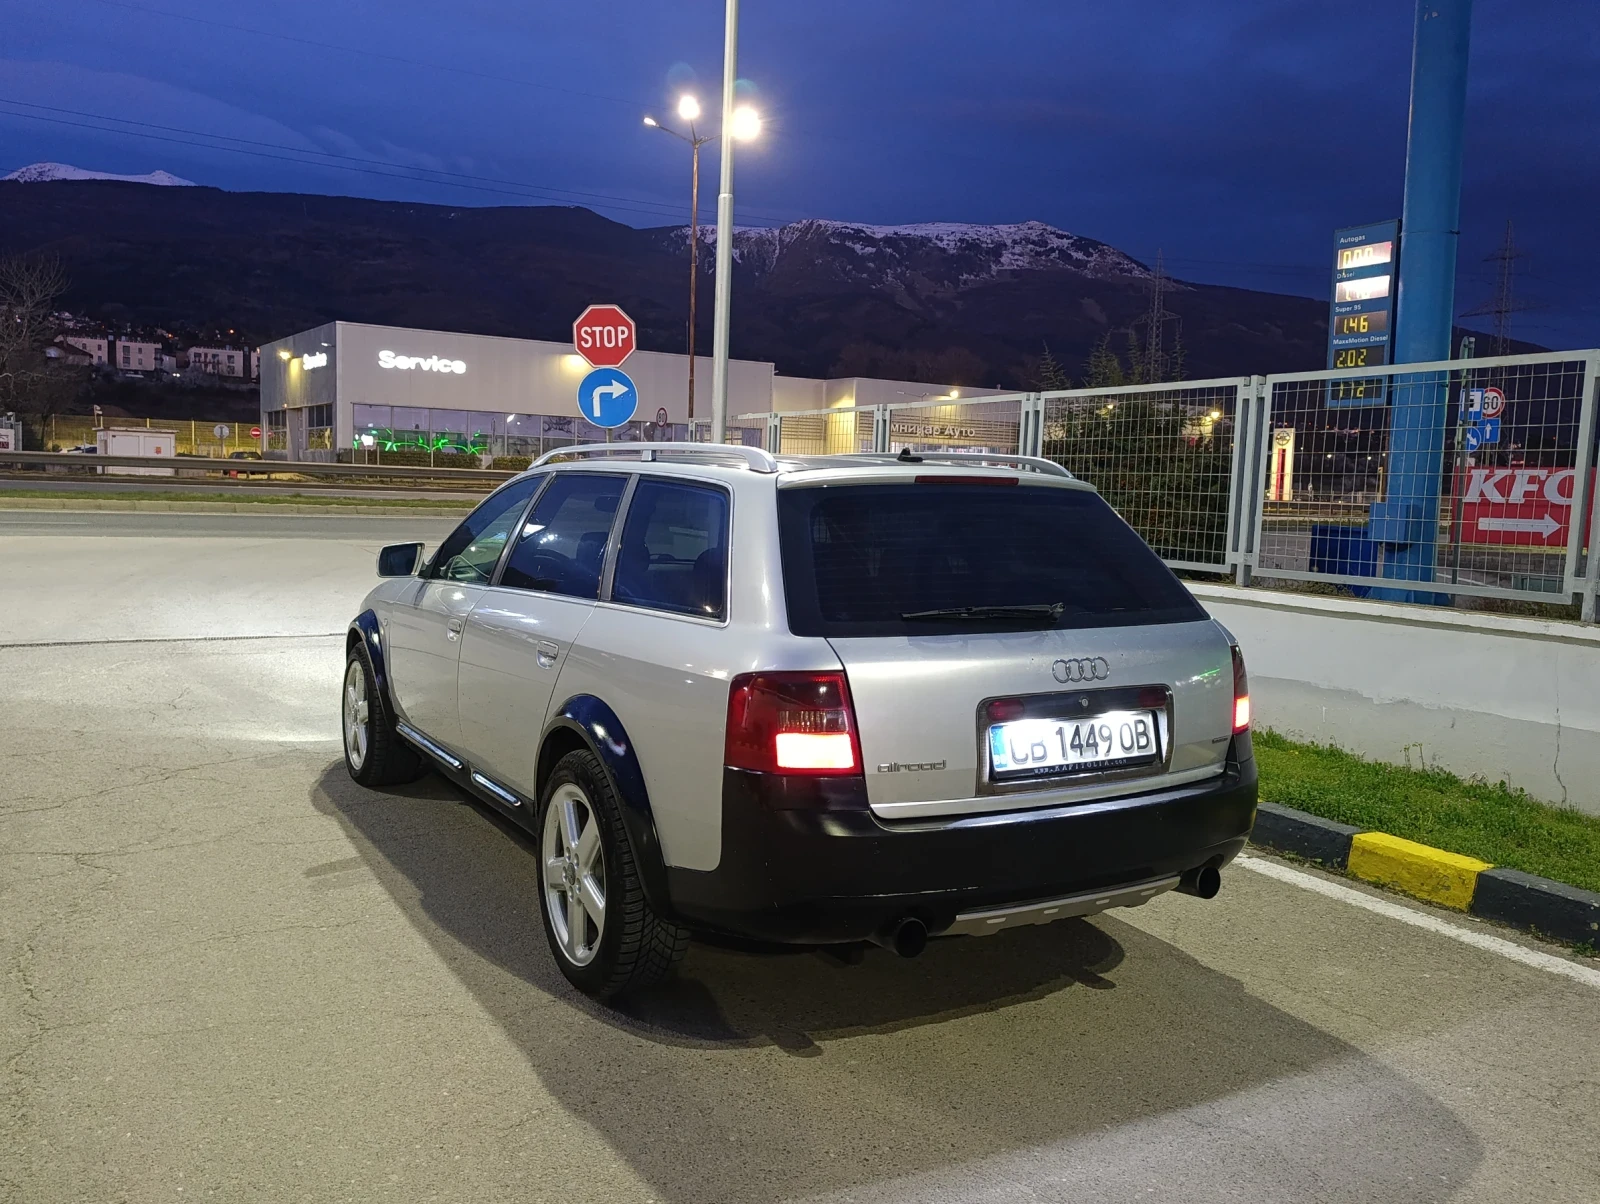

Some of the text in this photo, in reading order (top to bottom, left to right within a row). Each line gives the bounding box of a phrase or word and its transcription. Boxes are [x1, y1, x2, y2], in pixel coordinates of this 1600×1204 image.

[1340, 235, 1366, 243] Autogas
[1343, 314, 1369, 334] 1.46
[580, 325, 629, 348] STOP
[1370, 334, 1389, 342] Diesel
[378, 350, 466, 374] Service
[1336, 348, 1367, 368] 2.02
[1483, 395, 1499, 410] 60
[891, 423, 941, 436] мникар
[1462, 469, 1576, 505] KFC
[1056, 724, 1113, 760] 1449
[1120, 719, 1153, 754] OB
[878, 760, 946, 773] allroad
